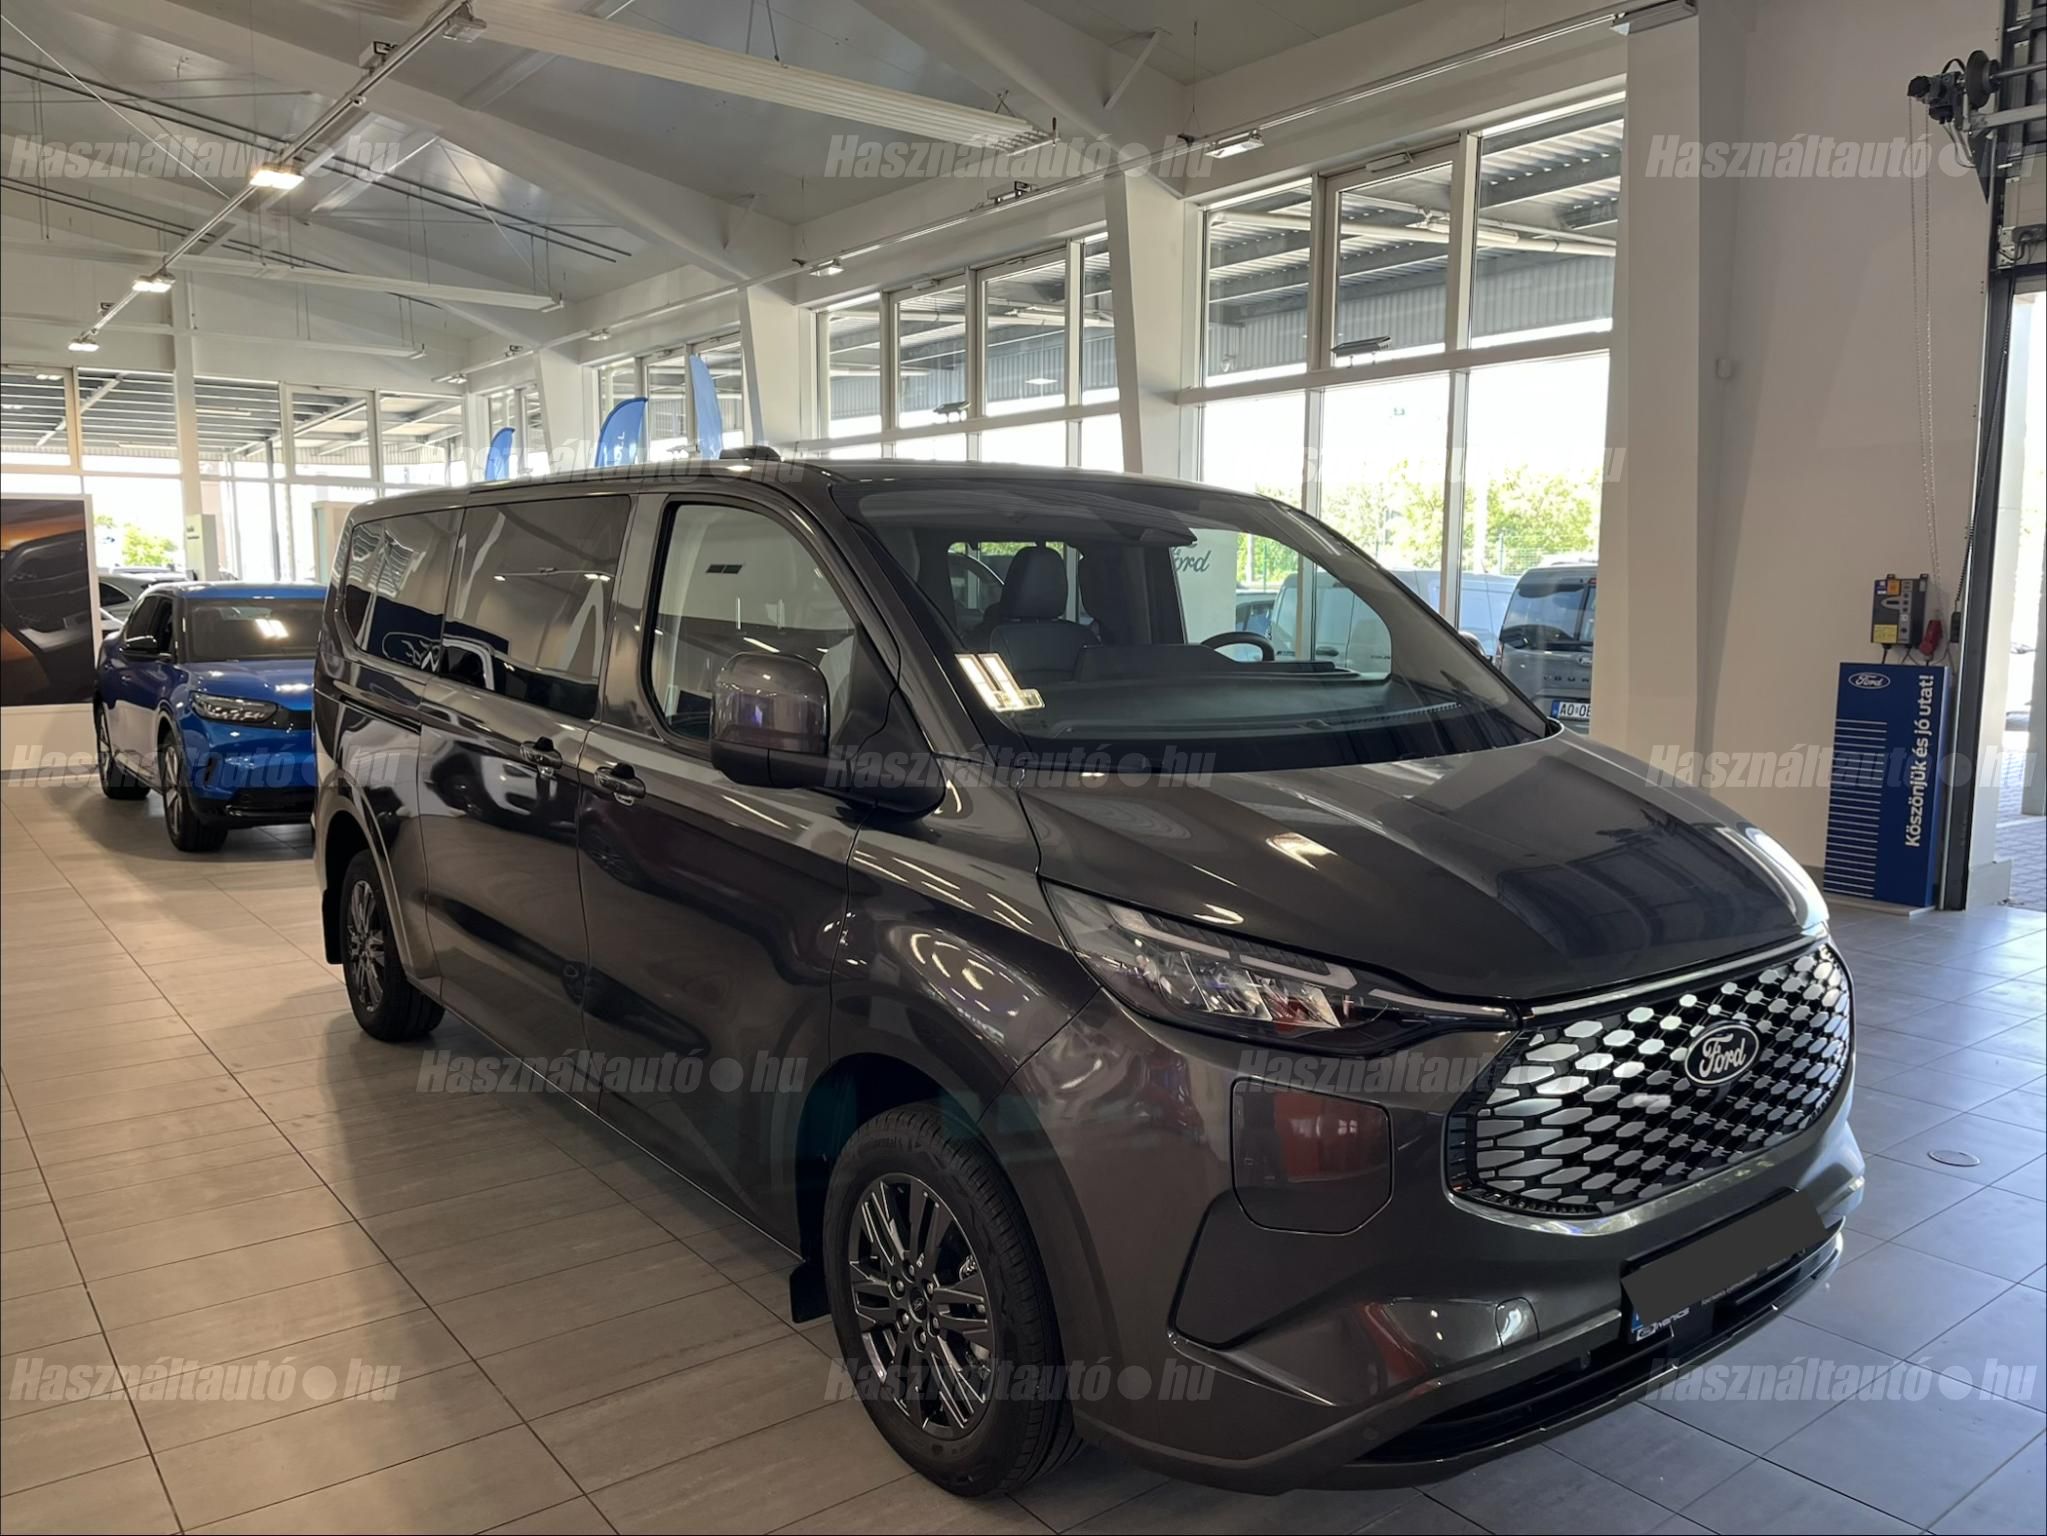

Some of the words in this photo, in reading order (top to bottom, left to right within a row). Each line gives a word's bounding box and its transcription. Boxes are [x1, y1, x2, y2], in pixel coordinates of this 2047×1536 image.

[1854, 673, 1885, 687] Ford
[1917, 675, 1935, 716] utat!
[1914, 719, 1932, 735] jó
[1912, 738, 1929, 758] és
[1905, 760, 1928, 847] Köszönjük
[1699, 1033, 1747, 1078] Ford
